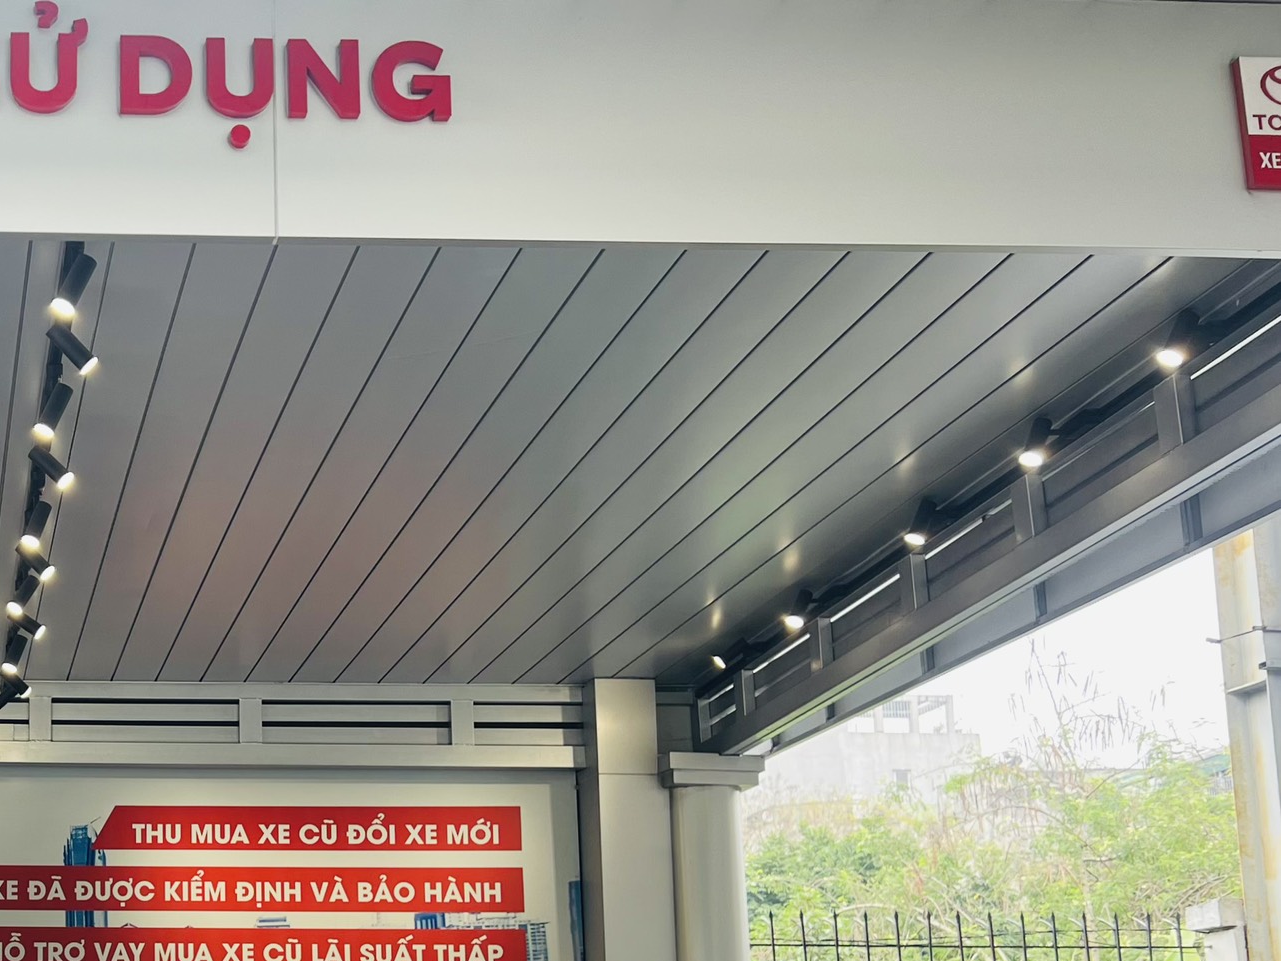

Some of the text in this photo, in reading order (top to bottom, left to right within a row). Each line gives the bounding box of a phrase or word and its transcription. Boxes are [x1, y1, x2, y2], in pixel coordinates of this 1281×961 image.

[119, 34, 452, 149] DỤNG
[132, 813, 499, 845] THU MUA XE CŨ ĐỔI XE MỚI
[27, 875, 66, 901] ĐÃ
[74, 878, 155, 907] ĐƯỢC
[165, 869, 226, 902] KIỂM
[235, 881, 301, 908] ĐỊNH
[310, 875, 349, 902] VÀ
[357, 874, 416, 903] BẢO
[424, 875, 502, 903] HÀNH
